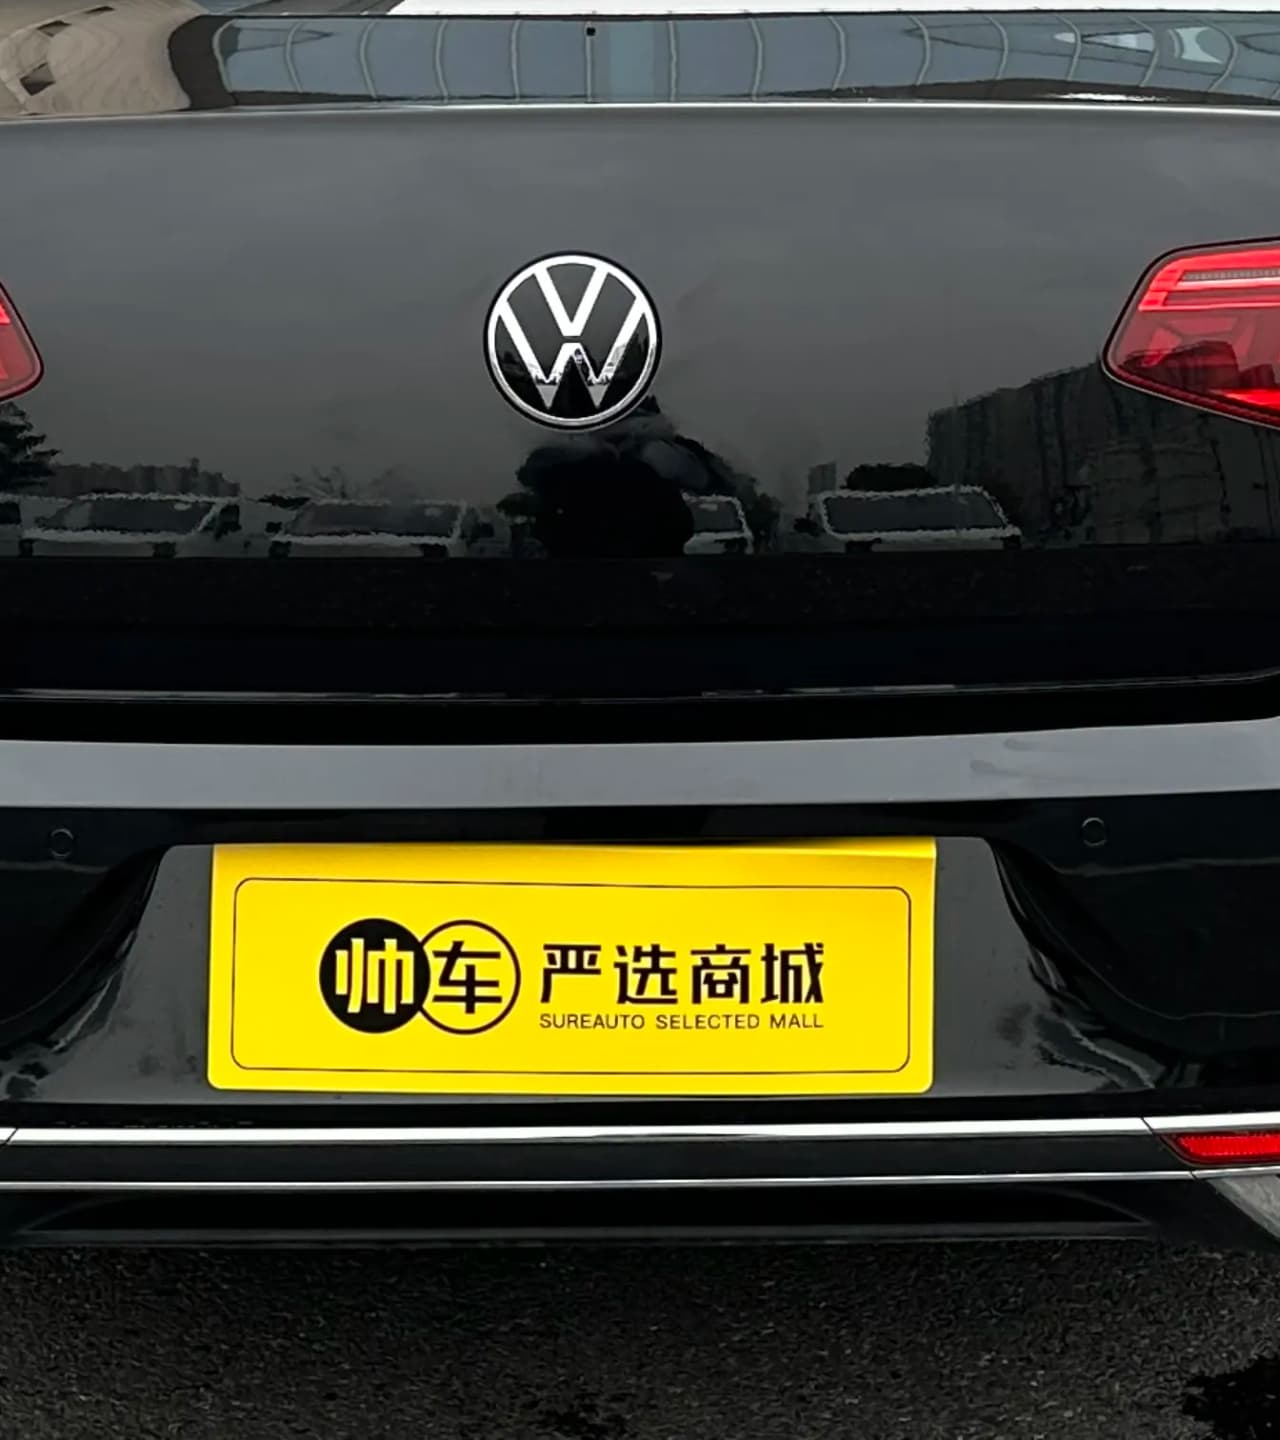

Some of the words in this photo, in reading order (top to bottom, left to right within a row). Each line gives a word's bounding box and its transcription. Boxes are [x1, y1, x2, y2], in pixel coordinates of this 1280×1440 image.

[539, 942, 825, 1005] 严选商城
[539, 1012, 646, 1030] SUREAUTO
[655, 1013, 761, 1030] SELECTED
[769, 1013, 825, 1030] MALL
